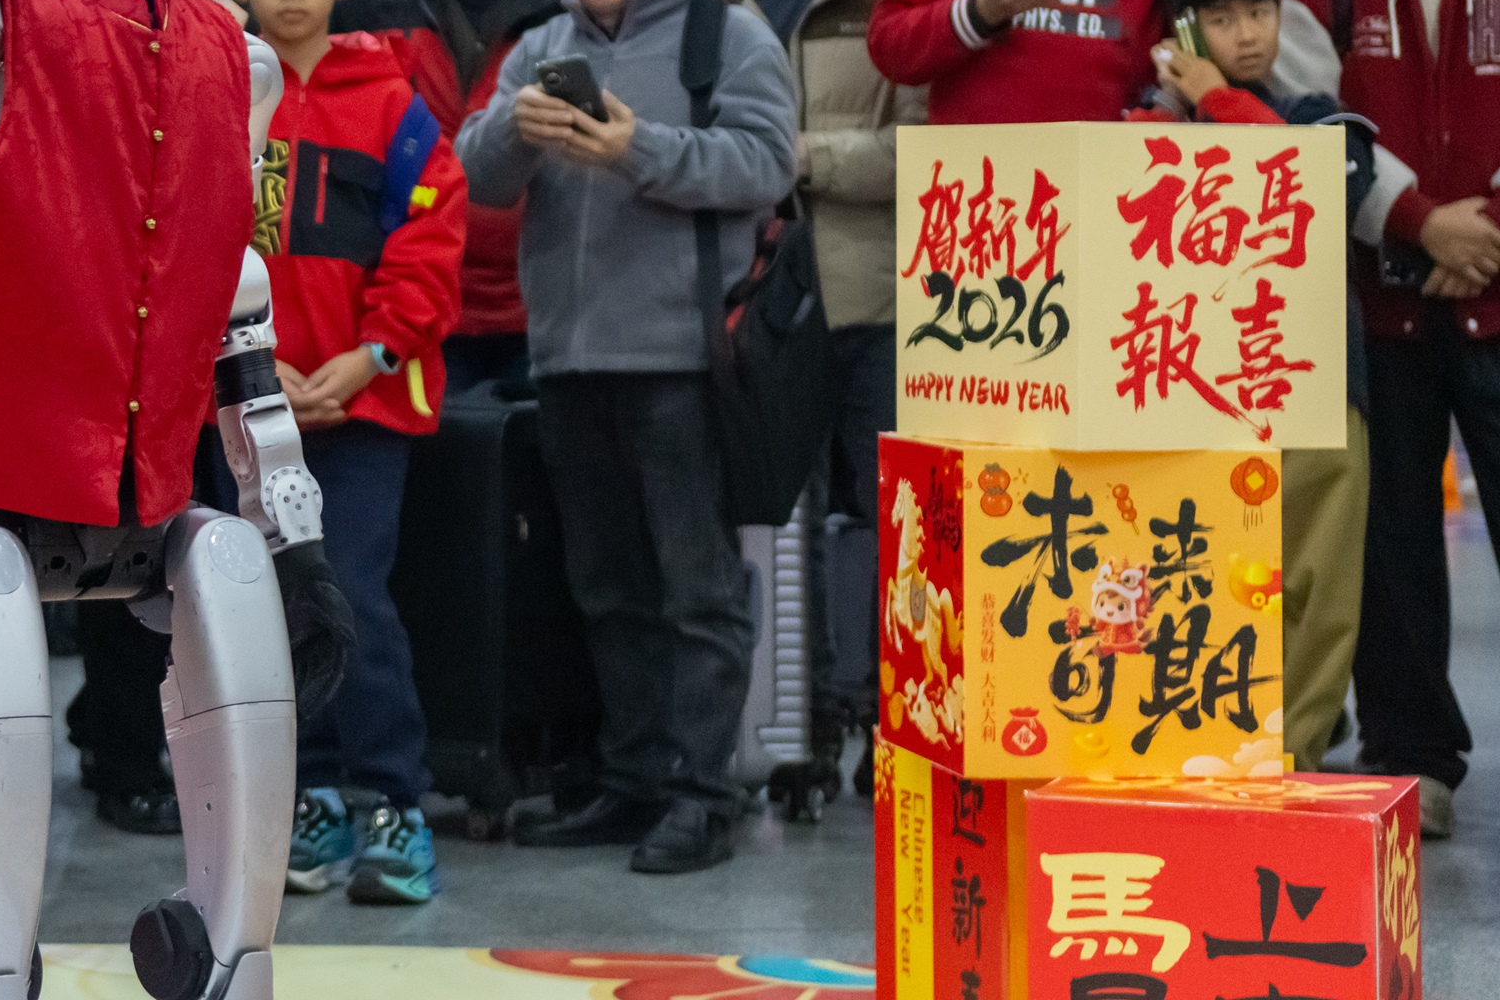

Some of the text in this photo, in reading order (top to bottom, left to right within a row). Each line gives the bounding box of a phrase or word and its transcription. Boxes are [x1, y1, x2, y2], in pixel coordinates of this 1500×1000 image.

[1077, 12, 1106, 38] ED.
[902, 155, 1071, 292] 贺新年
[1116, 135, 1316, 302] 福馬
[904, 269, 1071, 365] 2026
[1110, 277, 1316, 442] 報喜
[904, 371, 1071, 415] HAPPY NEW YEAR
[981, 464, 1216, 638] 未来
[981, 593, 997, 743] 恭喜发财 大吉大利
[1048, 604, 1283, 756] 可期
[899, 787, 914, 979] New Year
[912, 791, 927, 926] Chinese
[1040, 851, 1369, 973] 馬上
